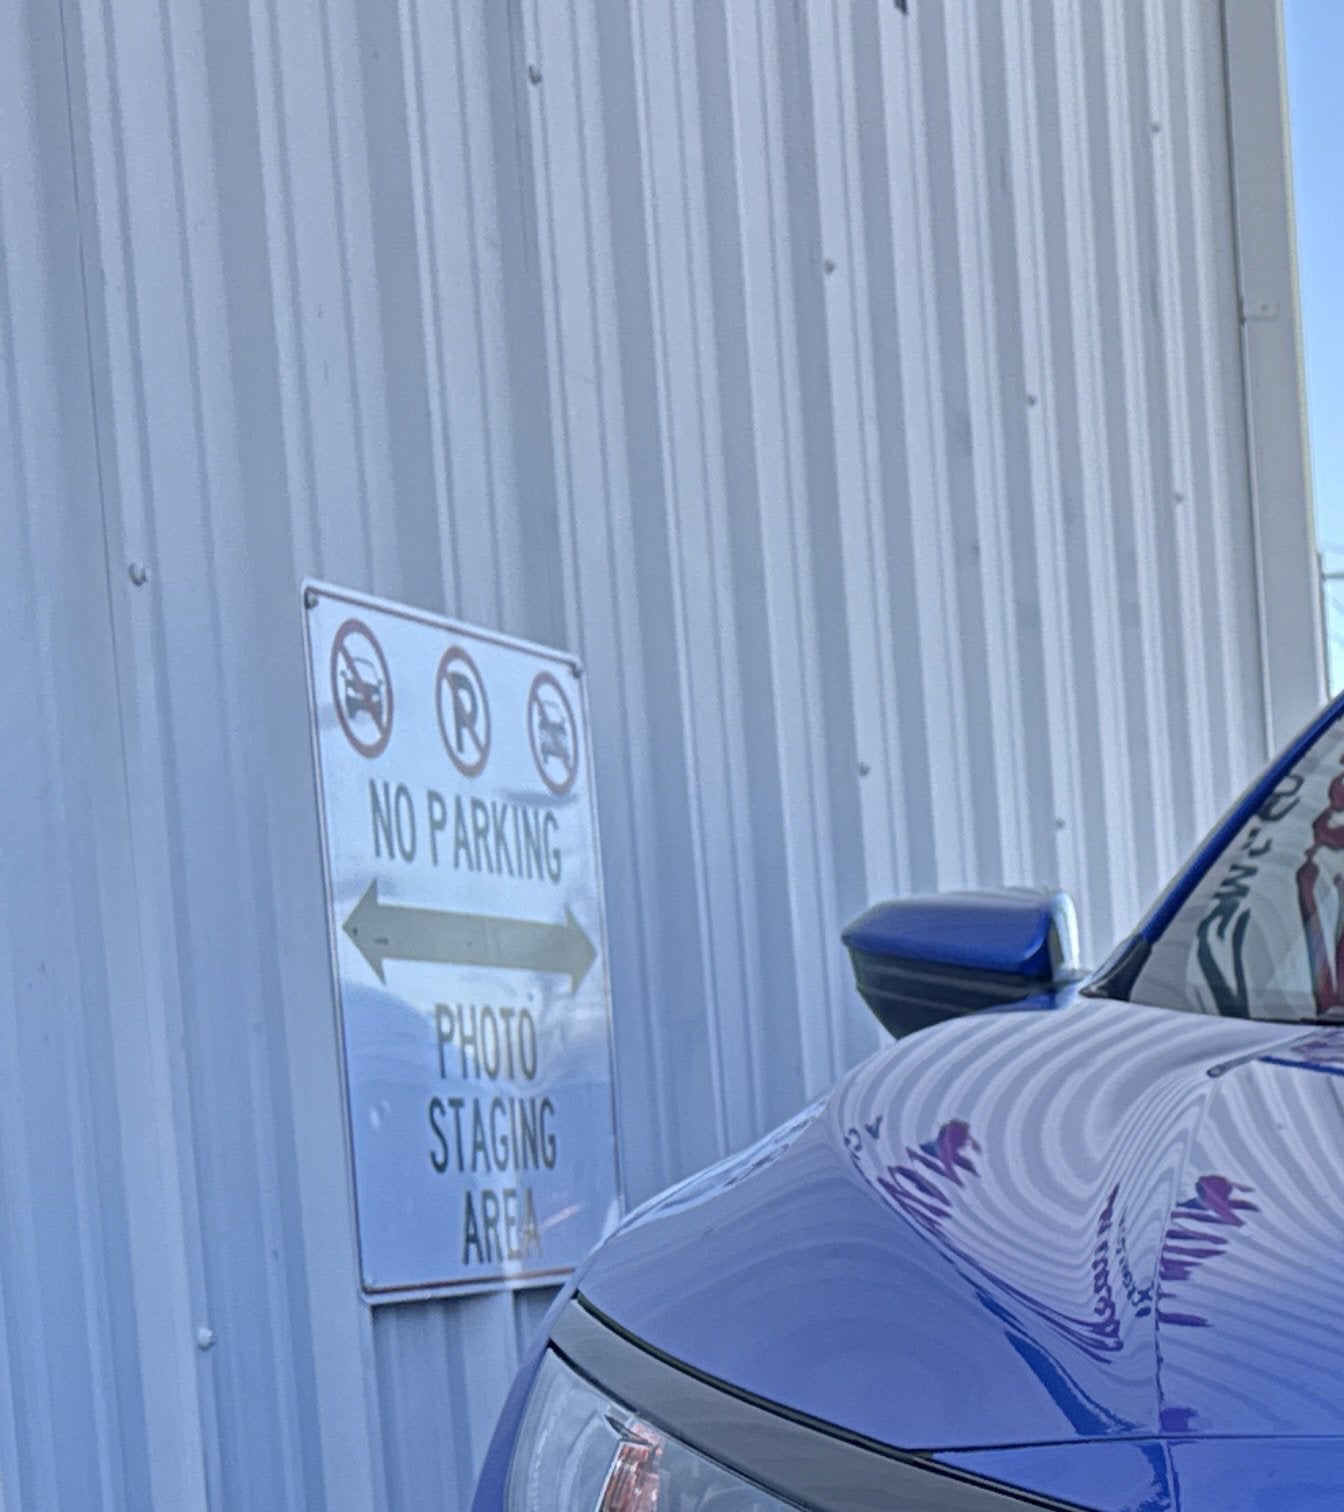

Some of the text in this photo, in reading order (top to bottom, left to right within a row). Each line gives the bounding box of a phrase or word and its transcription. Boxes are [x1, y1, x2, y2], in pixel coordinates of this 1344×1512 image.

[369, 778, 562, 884] NO PARKING
[434, 1003, 538, 1080] PHOTO
[428, 1096, 556, 1174] STAGING
[462, 1187, 544, 1265] AREA
